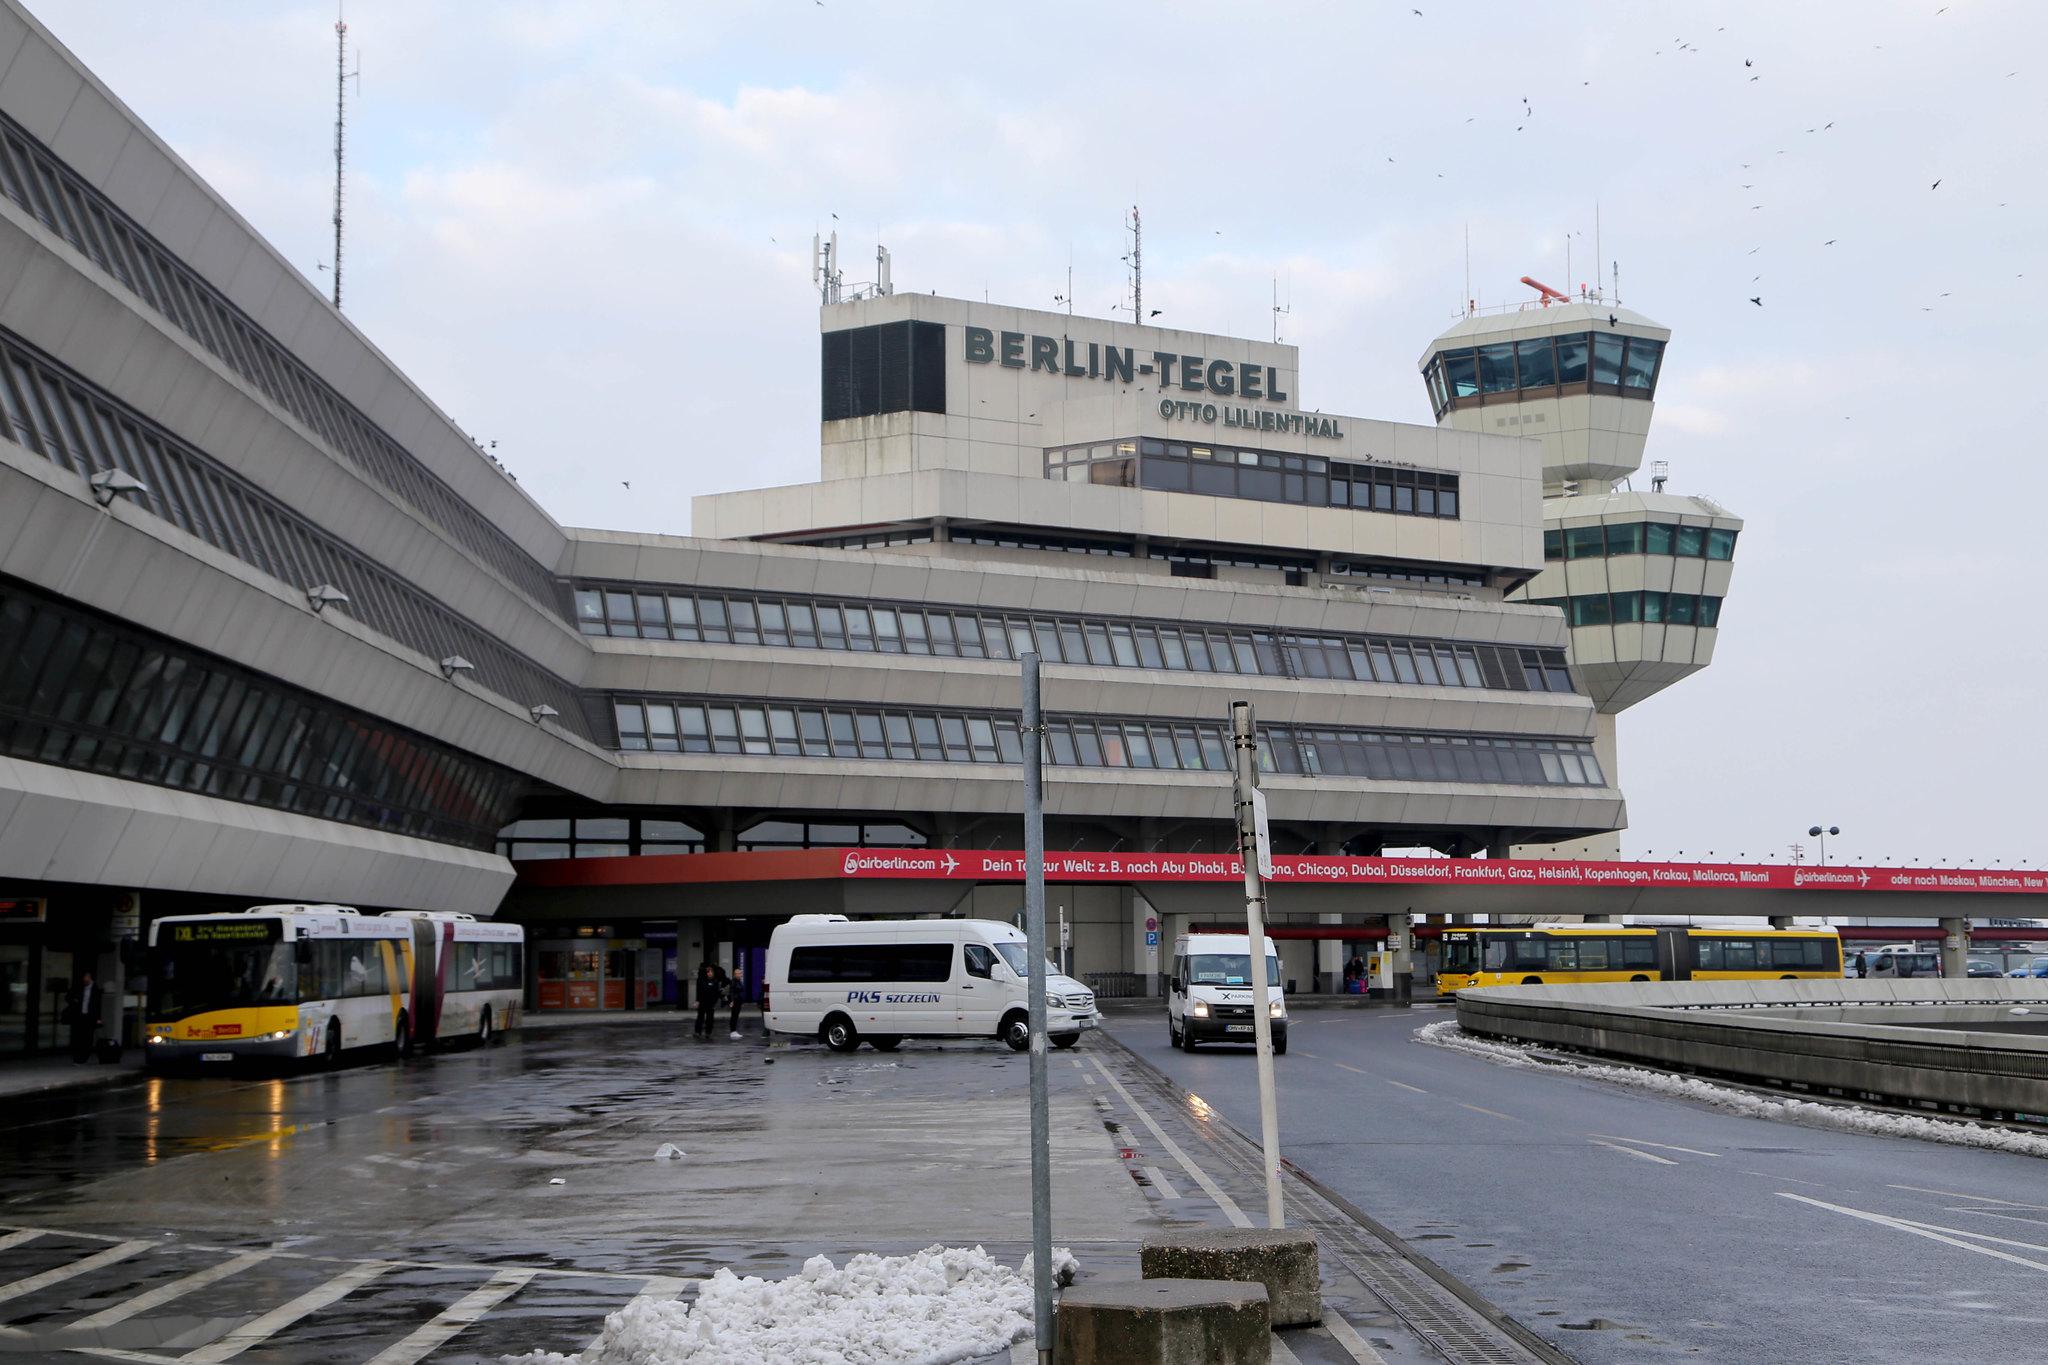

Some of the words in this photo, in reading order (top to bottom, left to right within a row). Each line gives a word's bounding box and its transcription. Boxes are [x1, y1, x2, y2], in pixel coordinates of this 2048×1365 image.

[963, 326, 1287, 401] BERLIN-TEGEL
[1158, 399, 1218, 425] OTTO
[1222, 406, 1343, 439] LILIENTHAL
[859, 856, 936, 870] airberlin.com
[983, 858, 1012, 872] Dein
[1063, 859, 1095, 873] Welt:
[1127, 860, 1158, 874] nach
[1162, 860, 1185, 875] Abu
[1189, 861, 1228, 876] Dhabi,
[1298, 862, 1349, 879] Chicago,
[1352, 863, 1387, 878] Dubai,
[1391, 864, 1451, 878] Düsseldorf,
[1455, 865, 1505, 879] Frankfurt,
[1508, 866, 1536, 880] Graz,
[1539, 866, 1582, 881] Helsinki,
[1585, 867, 1650, 882] Kopenhagen,
[1653, 868, 1690, 882] Krakau,
[1693, 869, 1738, 883] Mallorca,
[1740, 870, 1769, 882] Miami
[1804, 868, 1855, 883] airberlin.com
[1891, 873, 1912, 885] oder
[1915, 873, 1937, 886] nach
[1940, 874, 1977, 887] Moskau,
[1979, 875, 2022, 888] München,
[2024, 876, 2043, 887] New
[847, 991, 882, 1003] PKS
[886, 994, 941, 1003] SZCZECIN
